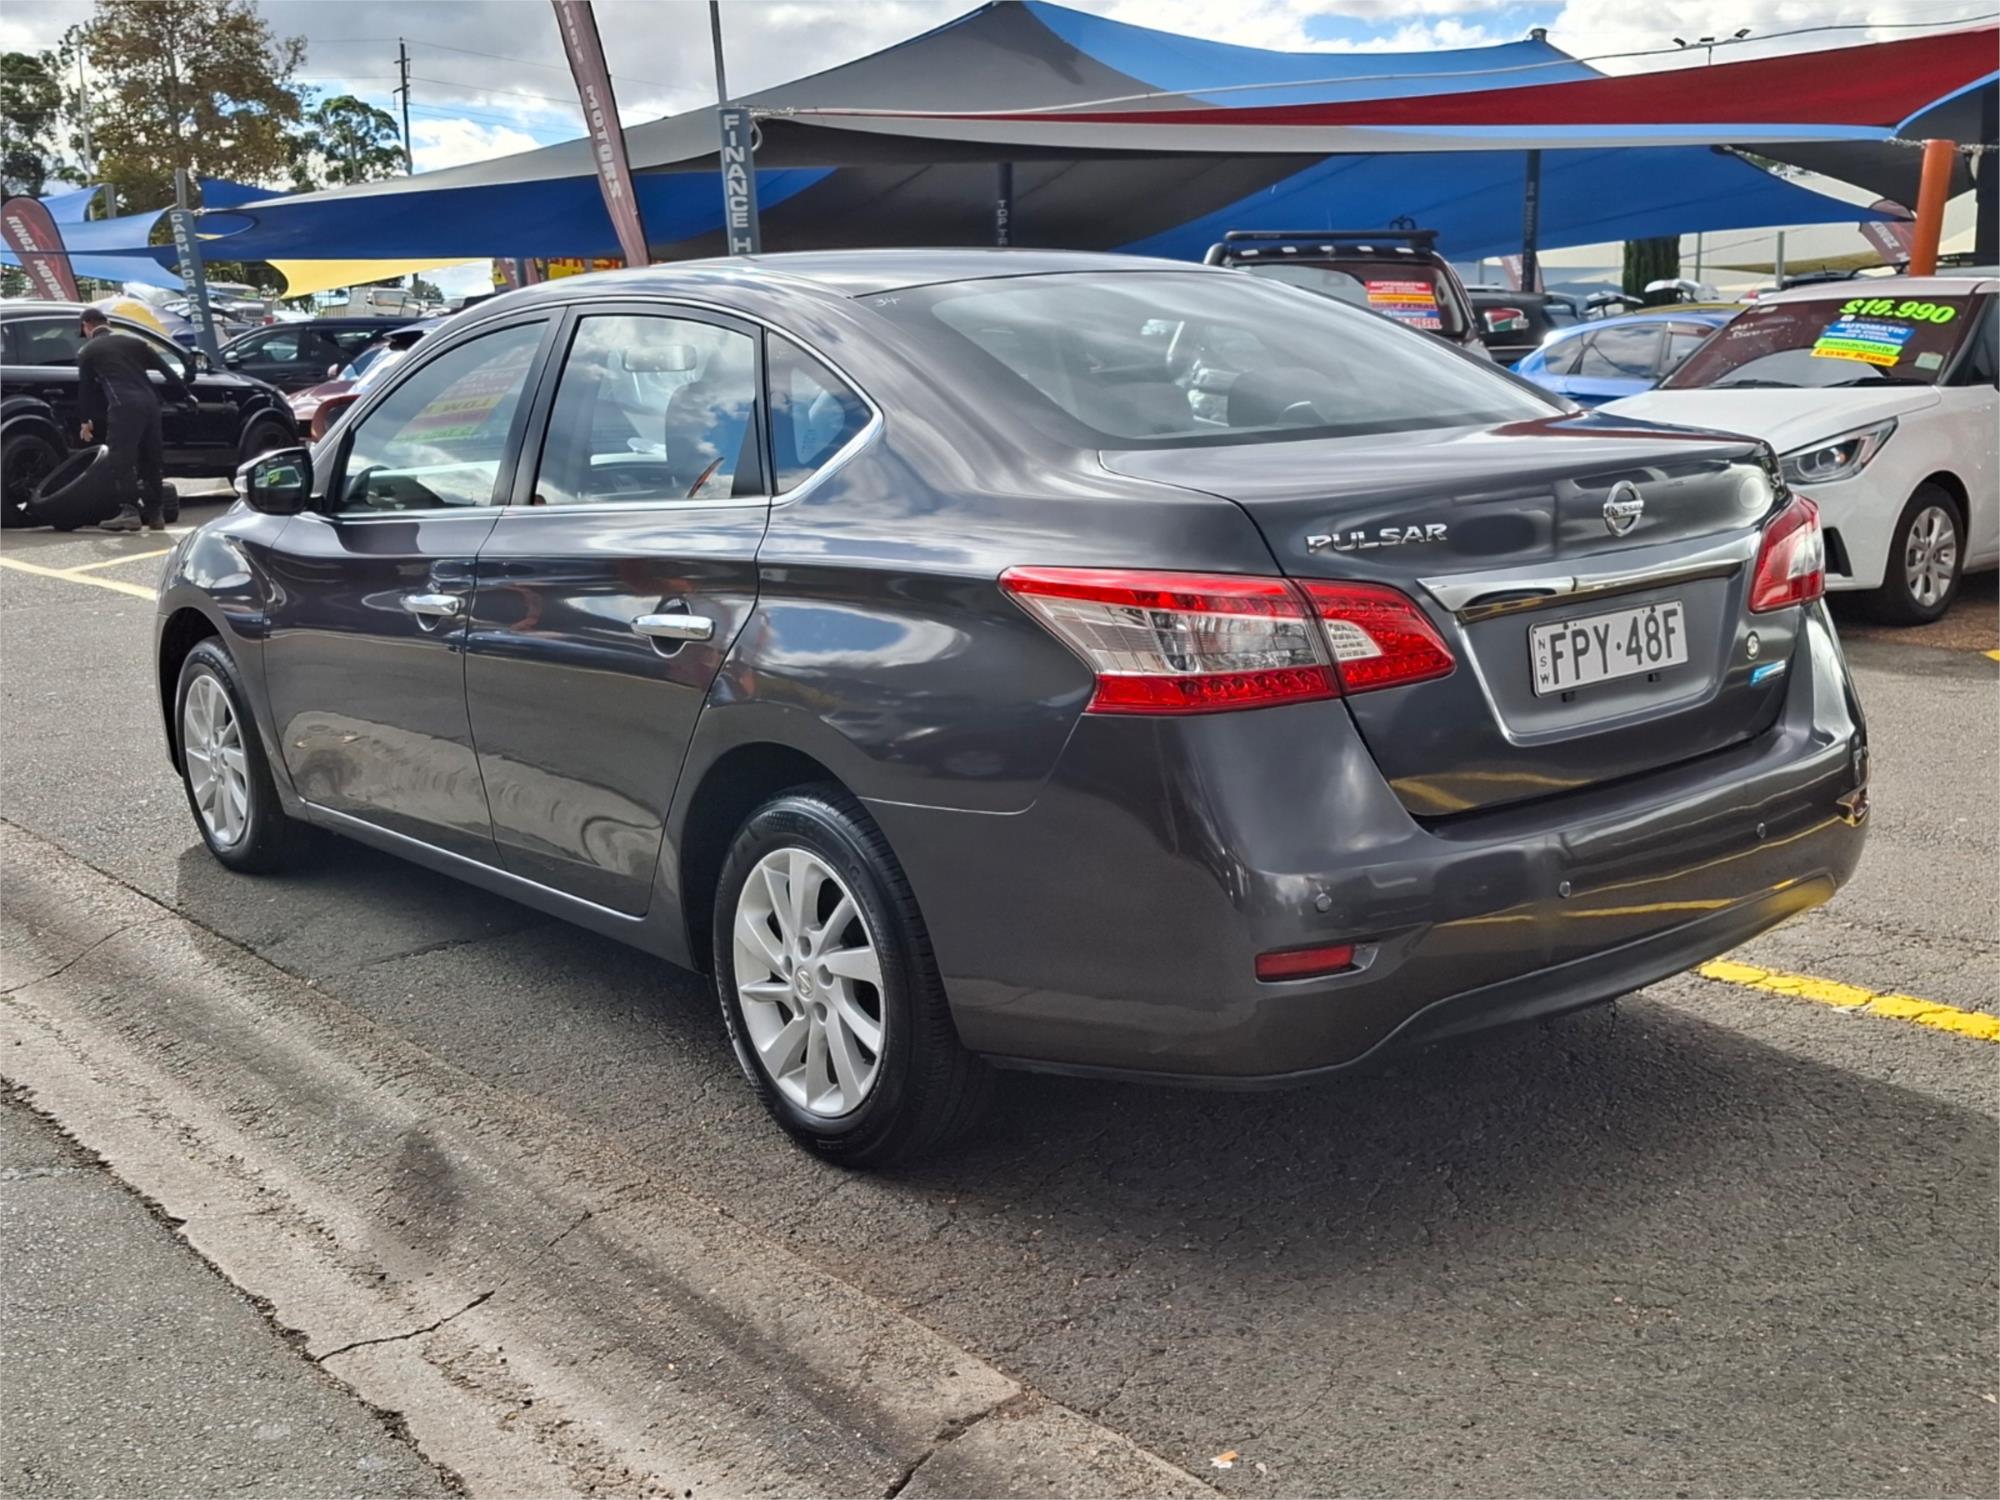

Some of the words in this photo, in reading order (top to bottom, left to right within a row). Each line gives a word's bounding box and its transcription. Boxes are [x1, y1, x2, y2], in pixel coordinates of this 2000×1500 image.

[586, 85, 622, 199] MOTORS
[723, 114, 749, 228] FINANCE
[170, 213, 190, 252] CASH
[997, 200, 1008, 226] TOP
[6, 216, 38, 252] KINGZ
[33, 260, 70, 300] MOTOR
[180, 260, 197, 288] FOR
[187, 294, 205, 333] CARS
[1837, 321, 1909, 335] AUTOMATIC
[1306, 523, 1448, 555] PULSAR
[1538, 639, 1550, 685] NSW
